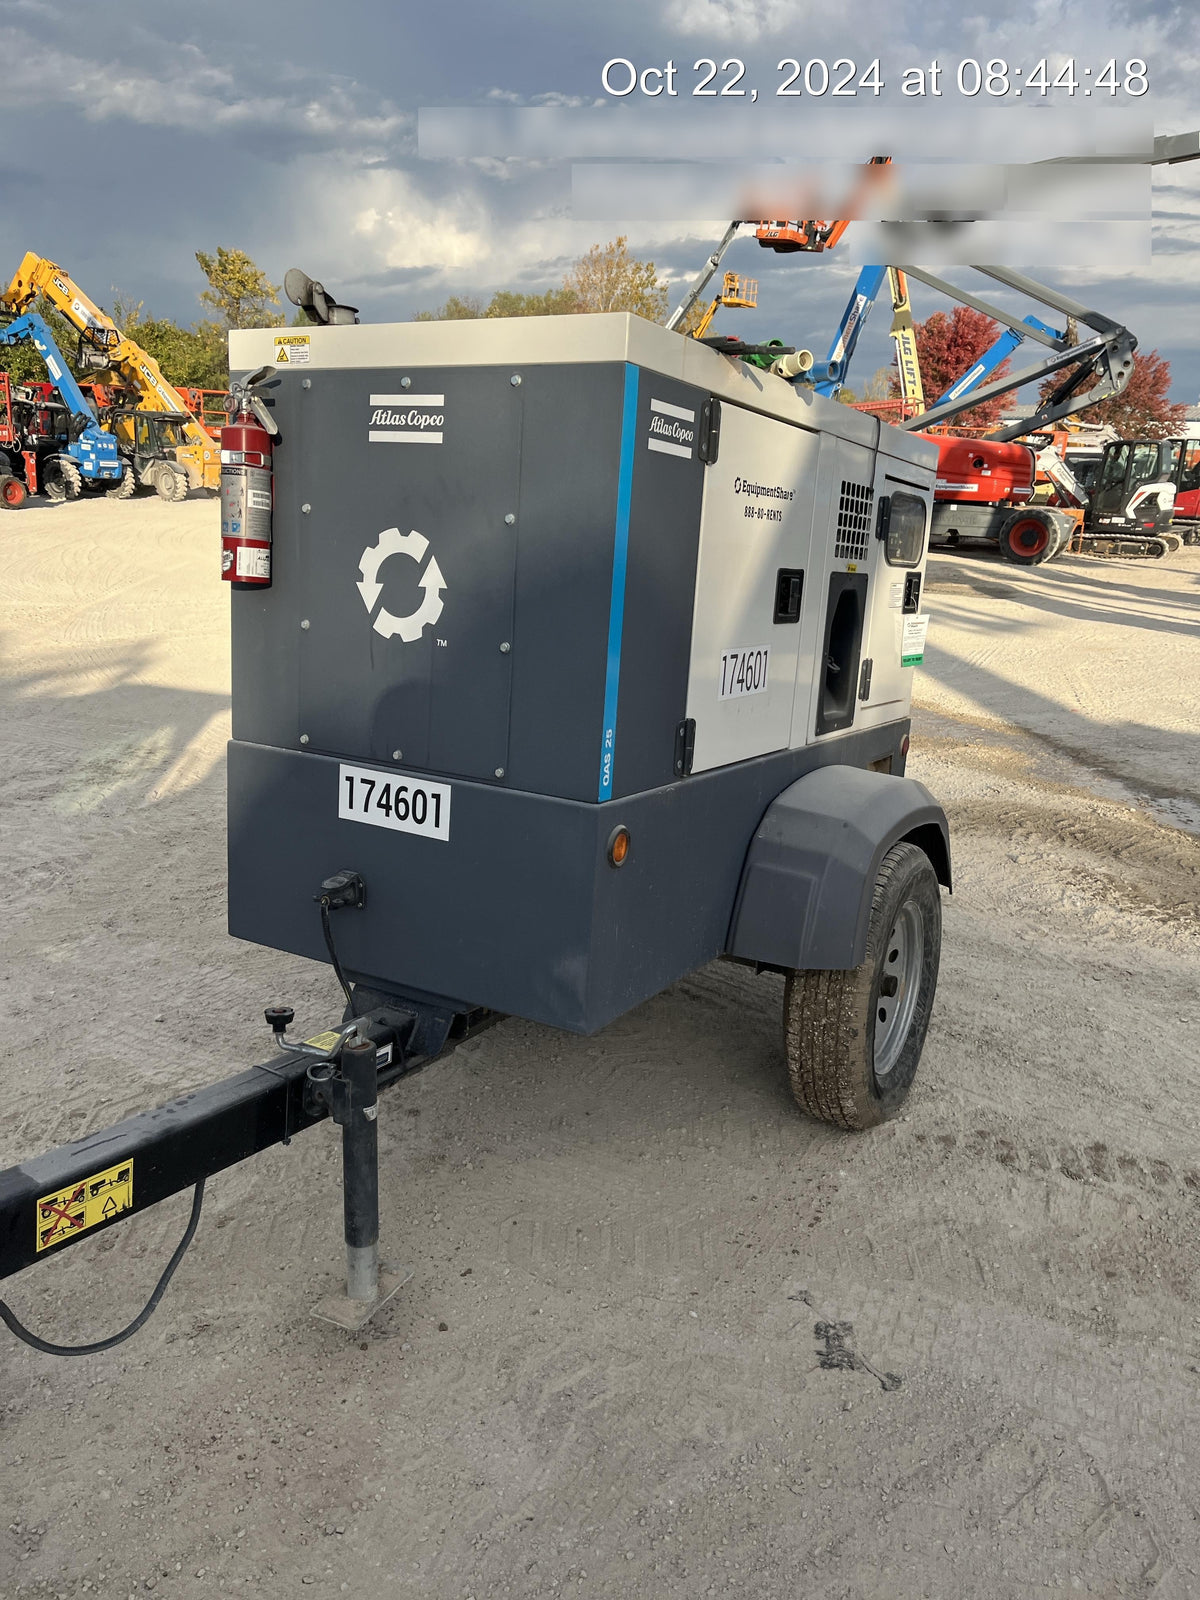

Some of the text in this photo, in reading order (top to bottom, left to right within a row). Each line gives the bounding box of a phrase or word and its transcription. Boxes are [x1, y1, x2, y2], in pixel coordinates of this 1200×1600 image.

[52, 275, 70, 296] JCB
[283, 337, 307, 345] CAUTION
[901, 333, 917, 387] JLG LIFT
[139, 362, 158, 387] JCB
[742, 480, 794, 501] EquipmentShare
[721, 650, 768, 696] 174601
[605, 728, 613, 748] 25
[345, 776, 442, 829] 174601
